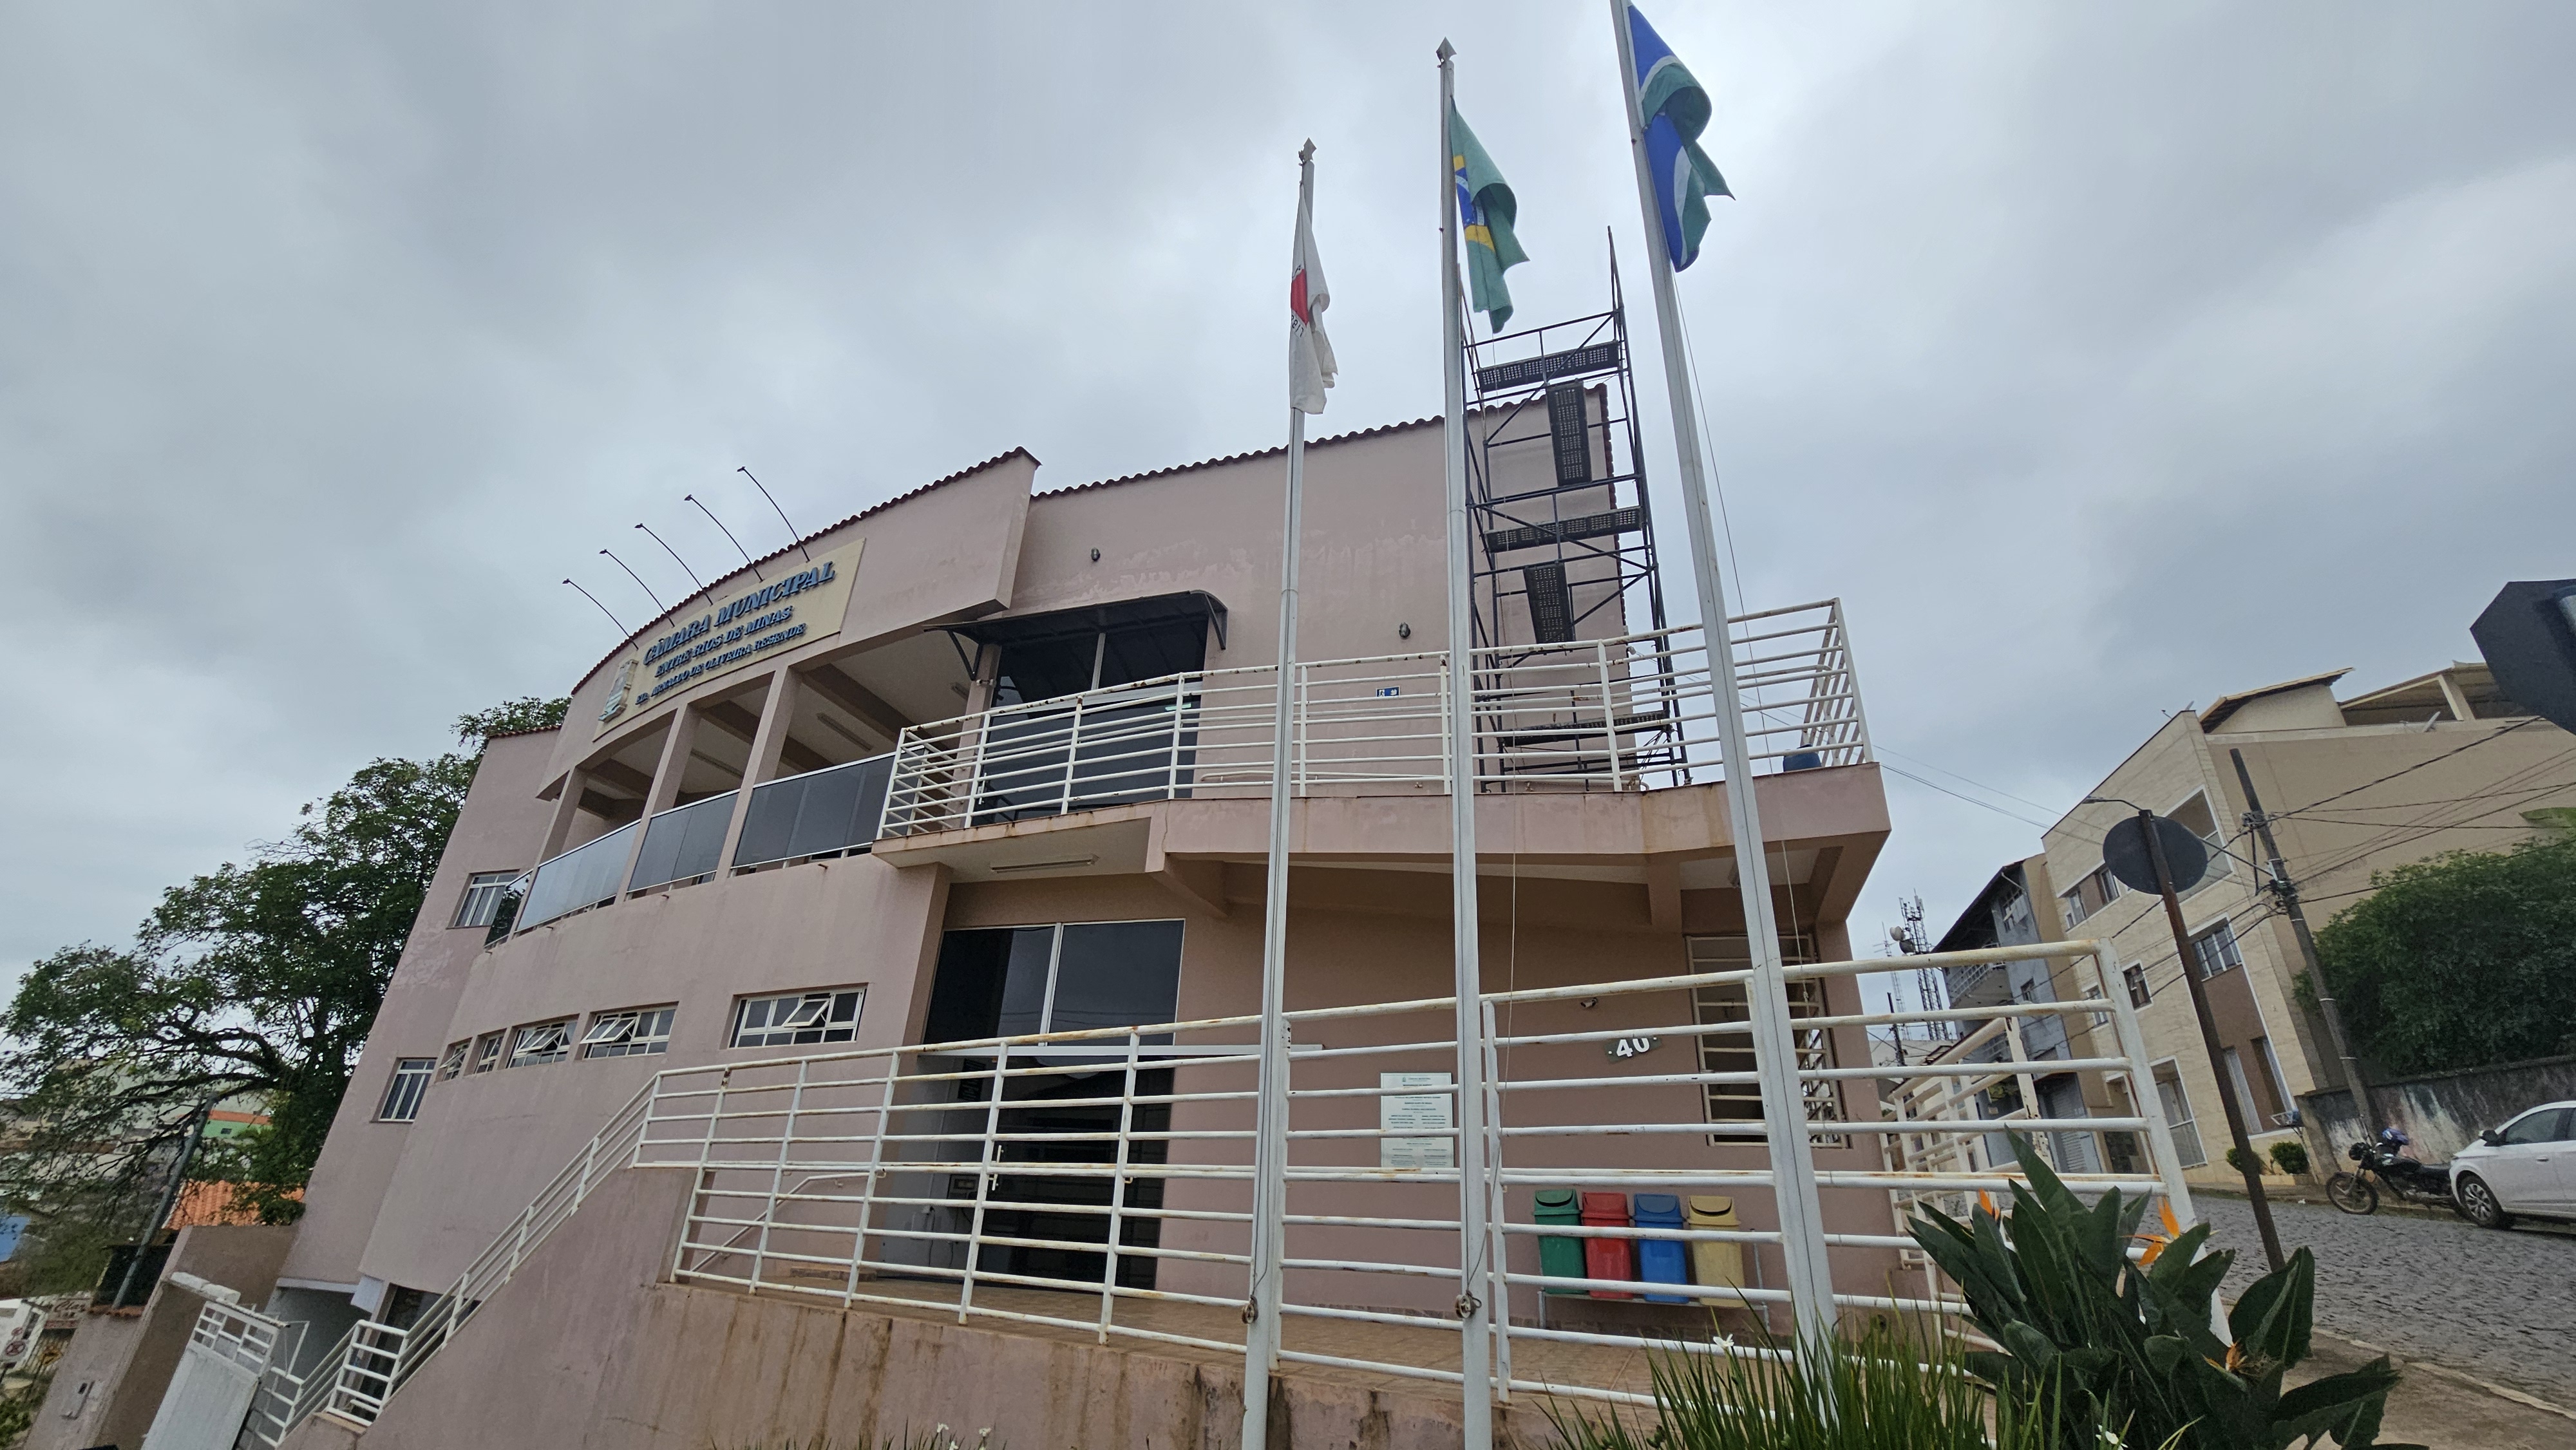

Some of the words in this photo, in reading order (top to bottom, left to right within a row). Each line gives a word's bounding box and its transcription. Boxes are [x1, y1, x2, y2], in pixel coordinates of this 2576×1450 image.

[643, 614, 712, 666] CÂMARA
[714, 561, 836, 627] MUNICIPAL
[654, 648, 693, 678] ENTRE
[692, 634, 724, 658] RIOS
[724, 625, 744, 644] DE
[744, 605, 793, 636] MINAS
[690, 663, 705, 677] DE
[705, 644, 753, 670] OLIVEIRA
[753, 623, 807, 652] RESENDE
[1616, 1037, 1650, 1058] 40
